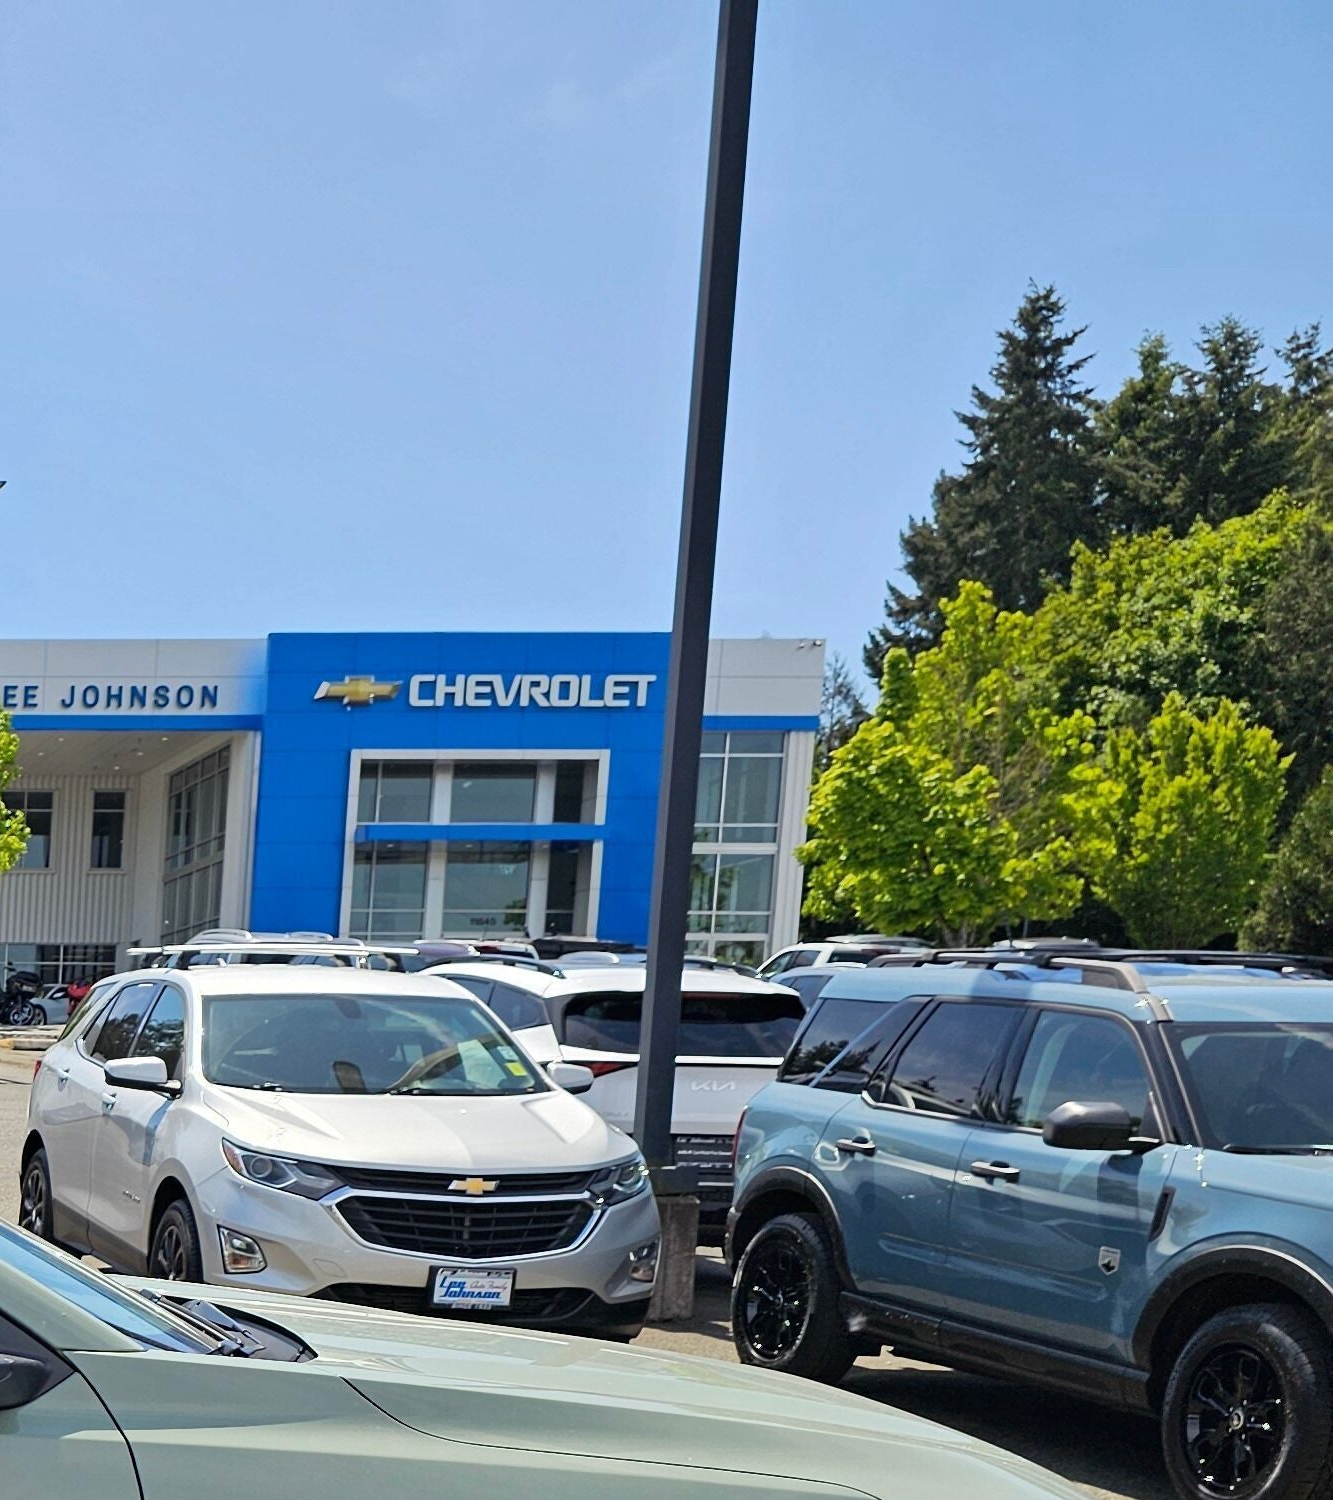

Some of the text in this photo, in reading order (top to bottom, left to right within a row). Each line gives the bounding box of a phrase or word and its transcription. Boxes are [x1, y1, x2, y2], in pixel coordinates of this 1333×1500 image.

[61, 685, 219, 709] JOHNSON
[408, 674, 657, 708] CHEVROLET
[691, 1081, 736, 1091] KIA
[439, 1276, 467, 1289] Lee
[439, 1286, 502, 1299] Johnson
